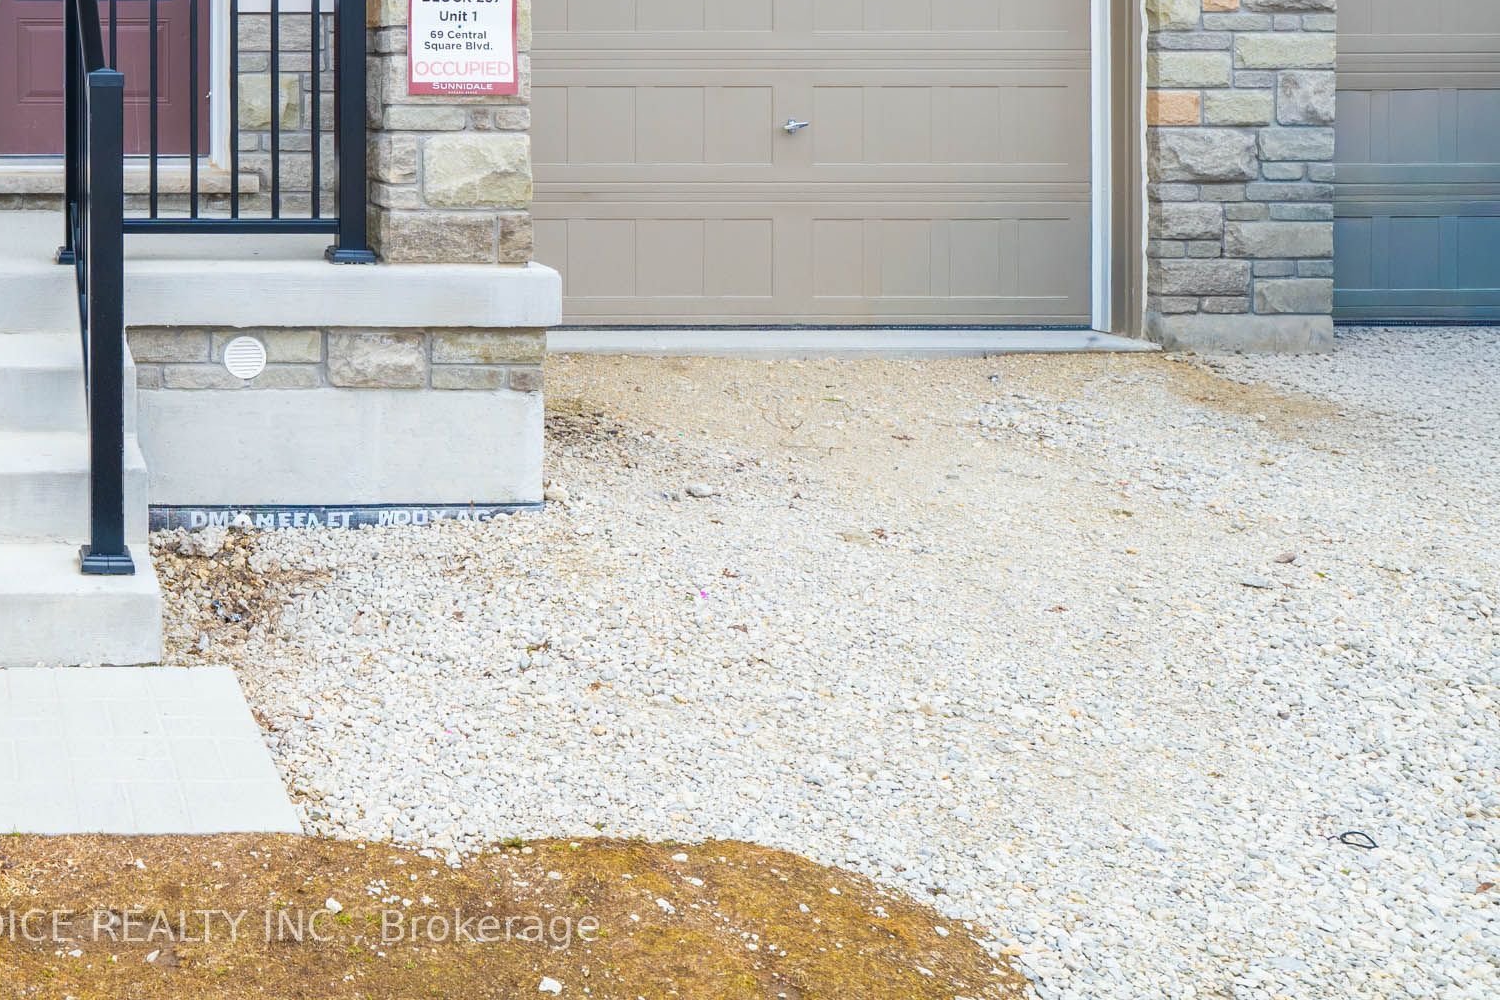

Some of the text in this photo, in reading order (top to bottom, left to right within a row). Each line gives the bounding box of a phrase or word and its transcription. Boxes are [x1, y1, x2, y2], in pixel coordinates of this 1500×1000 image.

[439, 11, 478, 22] Unit 1
[430, 31, 487, 40] 69 Central
[424, 41, 493, 52] Square Blvd.
[414, 61, 511, 77] OCCUPIED
[432, 82, 493, 90] SUNNIDALE
